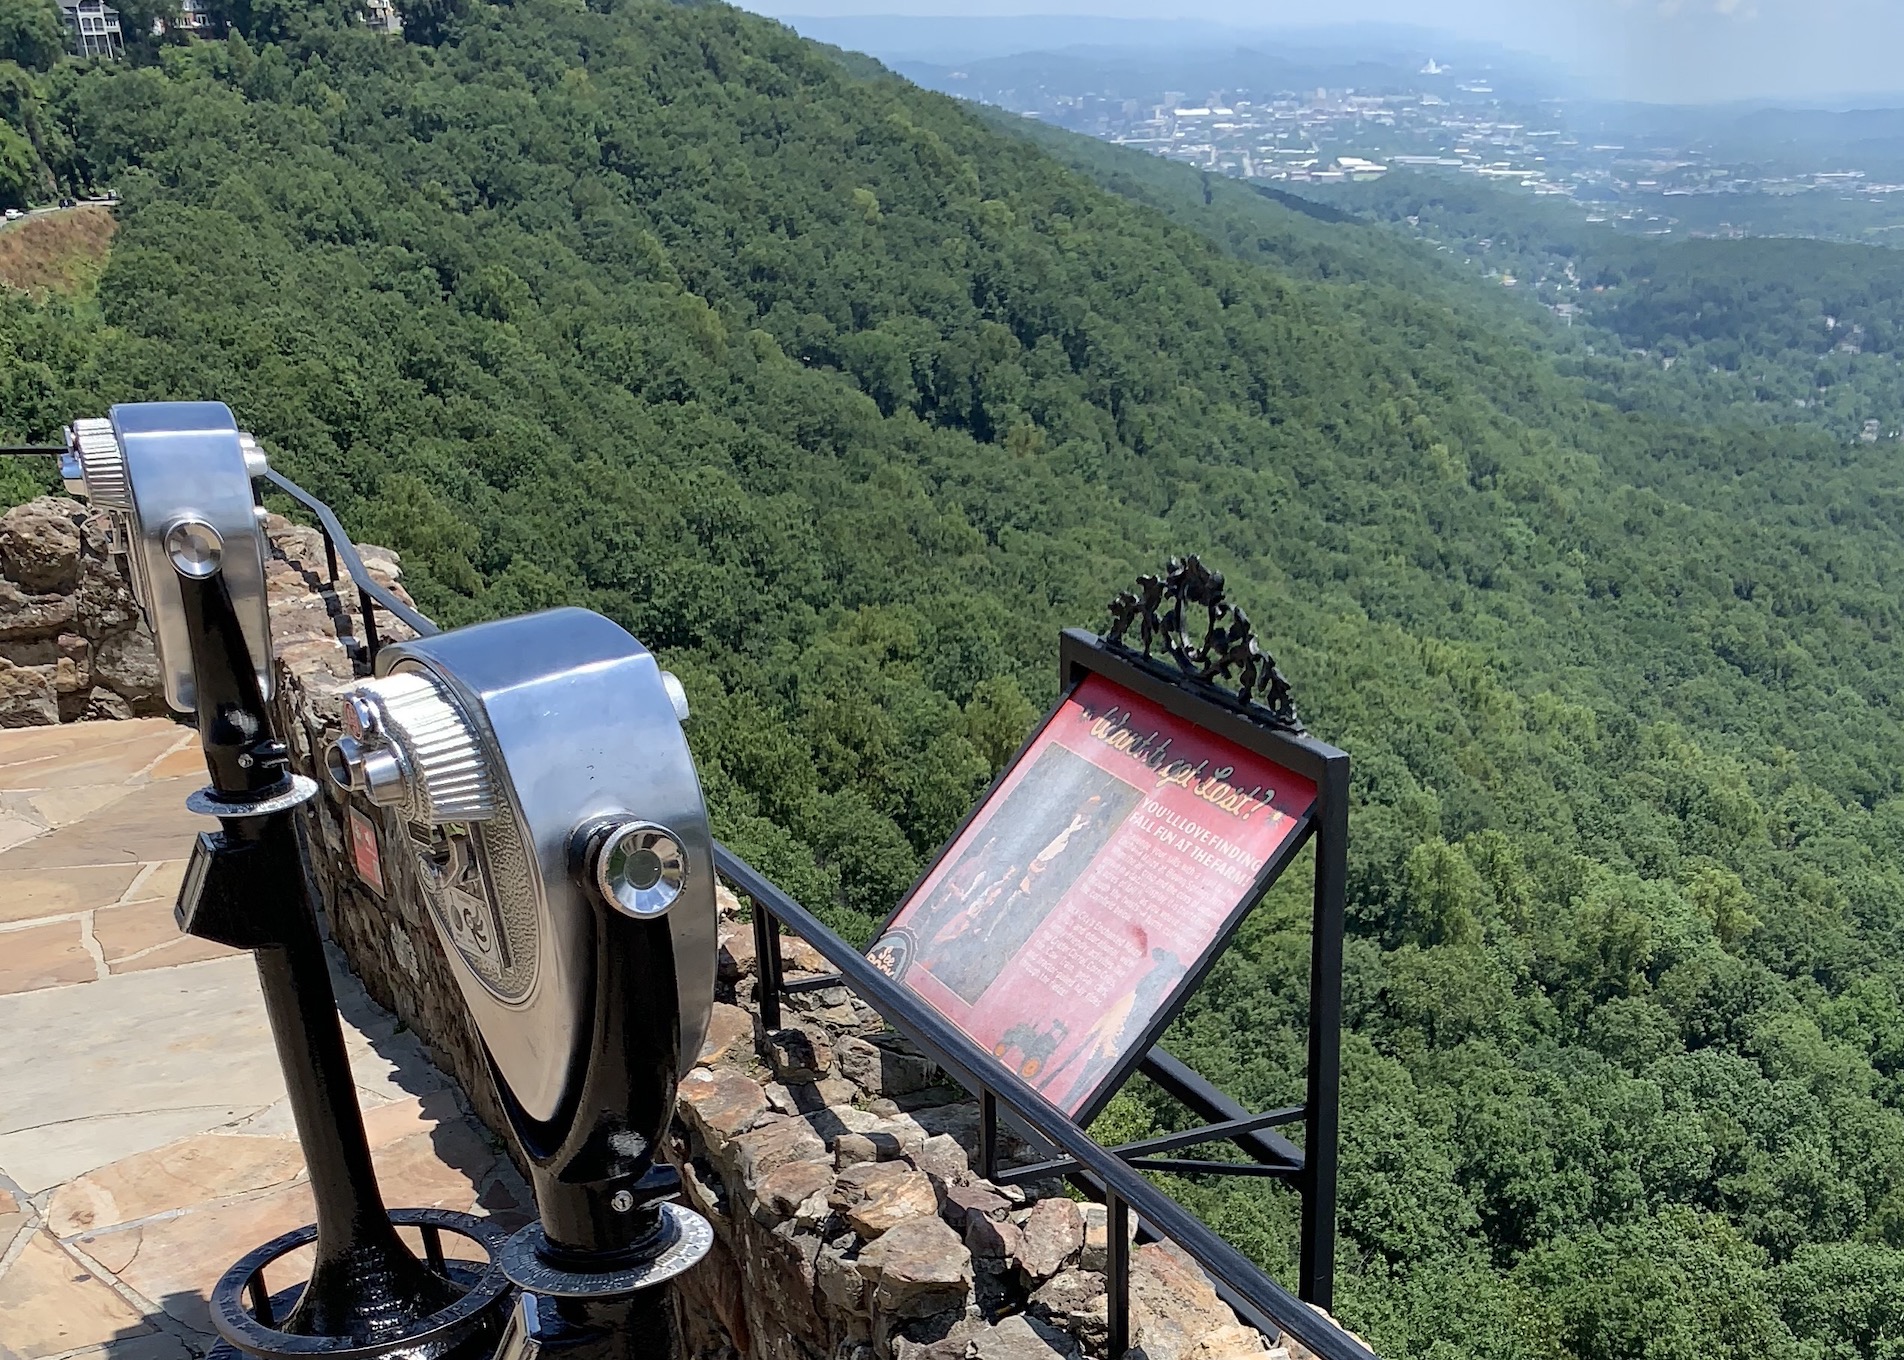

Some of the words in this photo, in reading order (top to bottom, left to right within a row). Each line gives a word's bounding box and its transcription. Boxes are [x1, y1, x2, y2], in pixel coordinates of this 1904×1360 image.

[1193, 766, 1276, 821] Lost?
[1129, 811, 1152, 833] FALL
[1154, 825, 1178, 845] FUN
[1174, 838, 1192, 854] AT
[1189, 844, 1215, 867] THE
[1212, 856, 1252, 888] FARM!
[1141, 797, 1182, 827] YOU'LL
[1178, 818, 1210, 843] LOVE
[1208, 831, 1263, 872] FINDING
